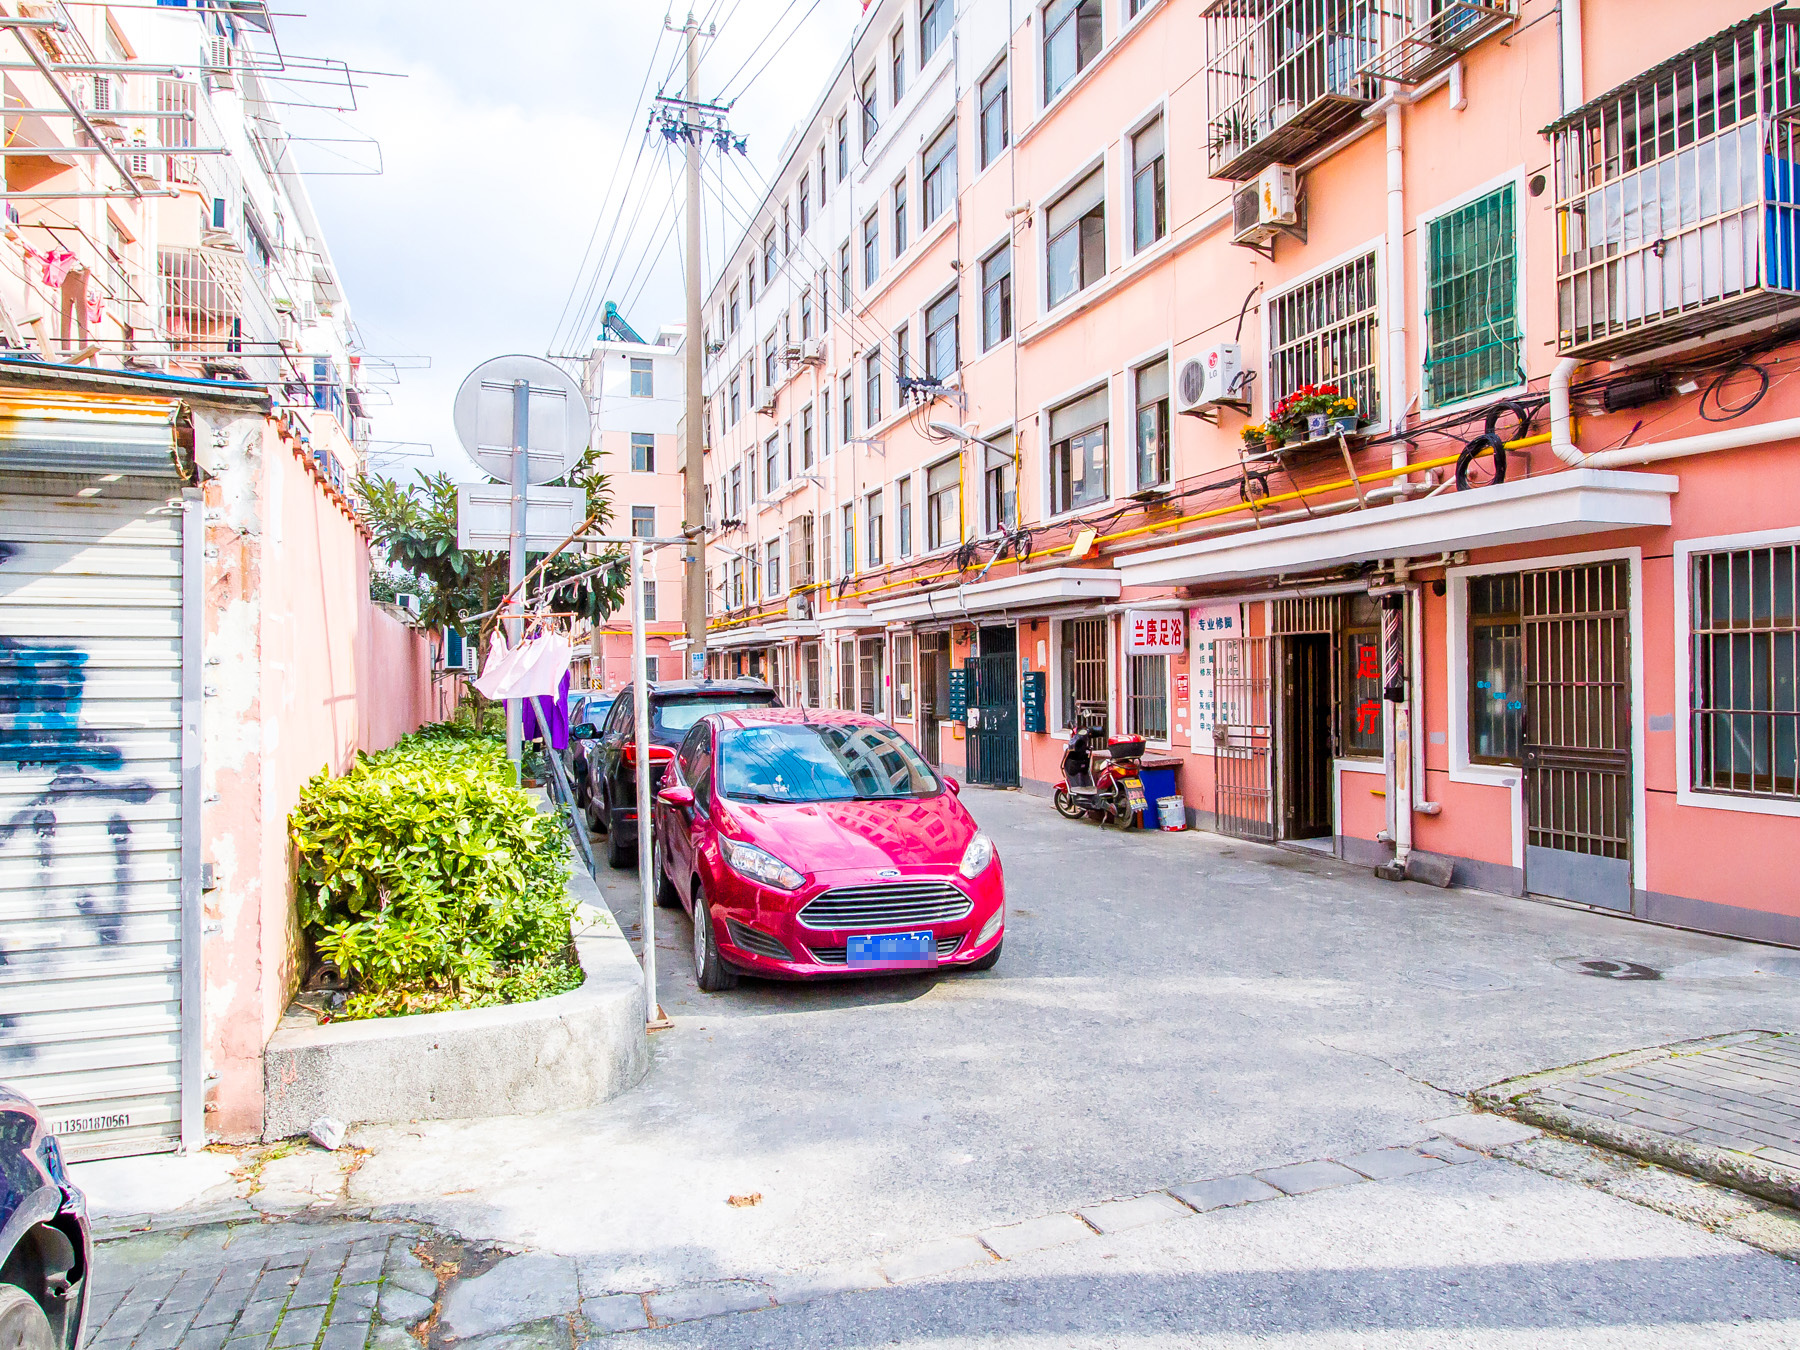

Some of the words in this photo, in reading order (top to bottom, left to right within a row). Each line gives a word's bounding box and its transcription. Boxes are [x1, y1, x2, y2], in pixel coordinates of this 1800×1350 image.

[1208, 369, 1218, 379] LG
[1134, 618, 1182, 647] 兰康足浴
[1356, 646, 1381, 735] 足疗
